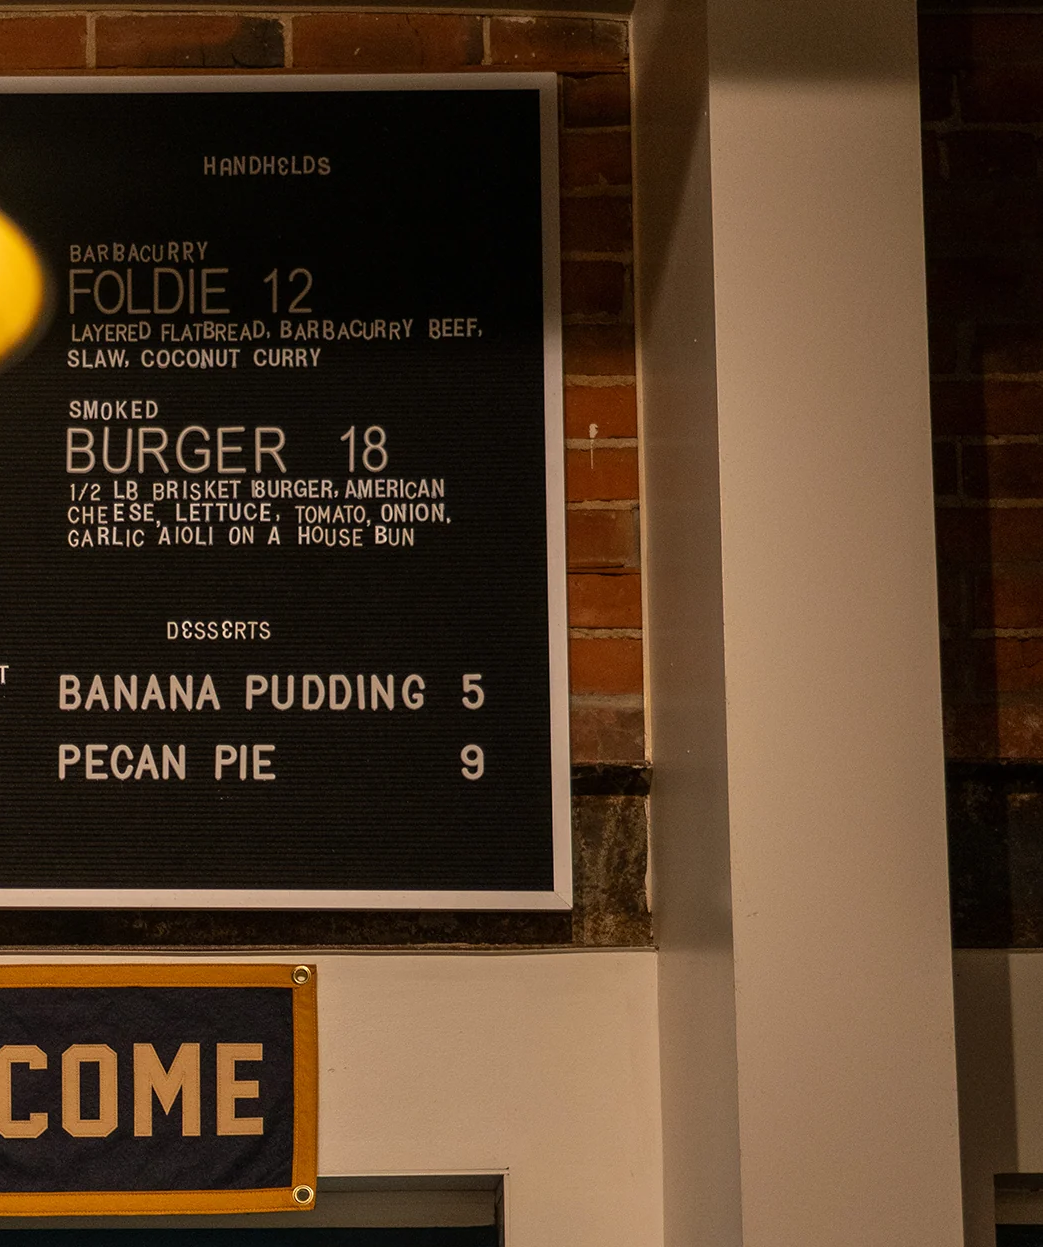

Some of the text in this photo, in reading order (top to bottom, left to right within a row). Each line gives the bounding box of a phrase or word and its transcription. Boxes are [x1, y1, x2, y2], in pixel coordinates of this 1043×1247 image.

[204, 156, 330, 176] HANDHELDS
[70, 242, 207, 262] BARBACURRY
[69, 268, 312, 314] FOLDIE 12
[72, 318, 482, 342] LAYERED FLATBREAD, BARBACURRY BEEF,
[68, 348, 320, 370] SLAW, COCONUT CURRY
[70, 400, 158, 420] SMOKED
[67, 426, 387, 473] BURGER 18
[71, 479, 444, 501] 1/2 LB BRISKET BURGER, AMERICAN
[68, 503, 160, 528] CHEESE,
[176, 503, 280, 521] LETTUCE,
[295, 505, 370, 528] TOMATO,
[68, 524, 413, 547] GARLIC AIOLI ON A HOUSE BUN
[167, 621, 270, 639] DESSERTS
[59, 674, 484, 711] BANANA PUDDING 5
[59, 744, 484, 780] PECAN PIE 9
